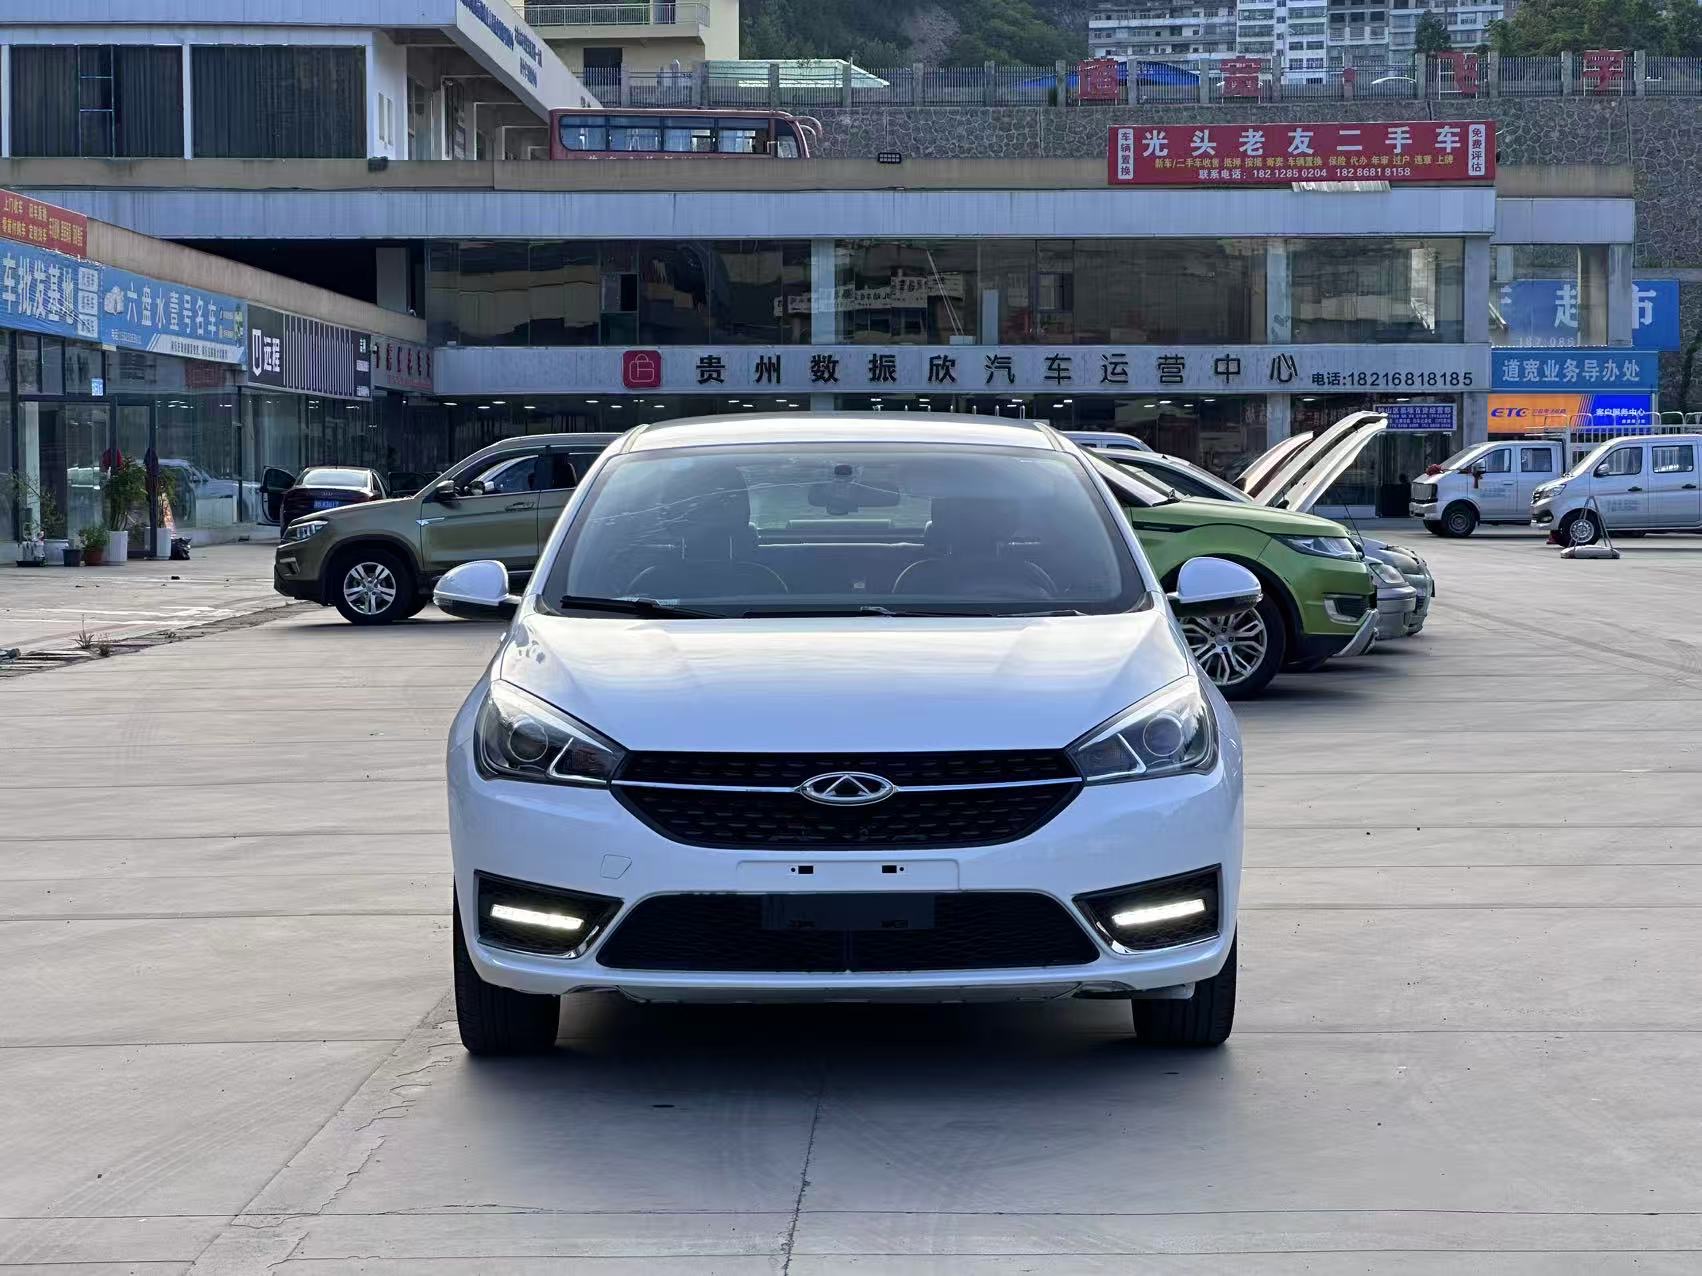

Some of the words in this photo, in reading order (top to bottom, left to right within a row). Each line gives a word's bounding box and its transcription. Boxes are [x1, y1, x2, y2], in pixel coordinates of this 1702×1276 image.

[1120, 131, 1132, 177] 车辆置换
[1141, 125, 1461, 157] 光头老友二手车
[1471, 127, 1482, 173] 免费评估
[1252, 169, 1270, 178] 182
[1275, 169, 1299, 178] 1285
[1301, 168, 1327, 177] 0204
[1336, 168, 1354, 177] 182
[1357, 168, 1381, 177] 8681
[1385, 167, 1411, 176] 8158
[1288, 156, 1322, 167] 车辆置换
[1329, 155, 1346, 166] 保险
[1350, 155, 1367, 166] 代办
[1371, 155, 1389, 166] 年审
[1392, 155, 1410, 165] 过户
[1436, 154, 1453, 165] 上牌
[127, 281, 217, 339] 六盘水壹号名车
[263, 336, 280, 373] 远程
[696, 353, 1298, 384] 贵州数振欣汽车运营中心
[1502, 358, 1640, 382] 道宽业务导办处
[1312, 371, 1473, 386] 电话:18216818185
[1490, 407, 1529, 418] ETC
